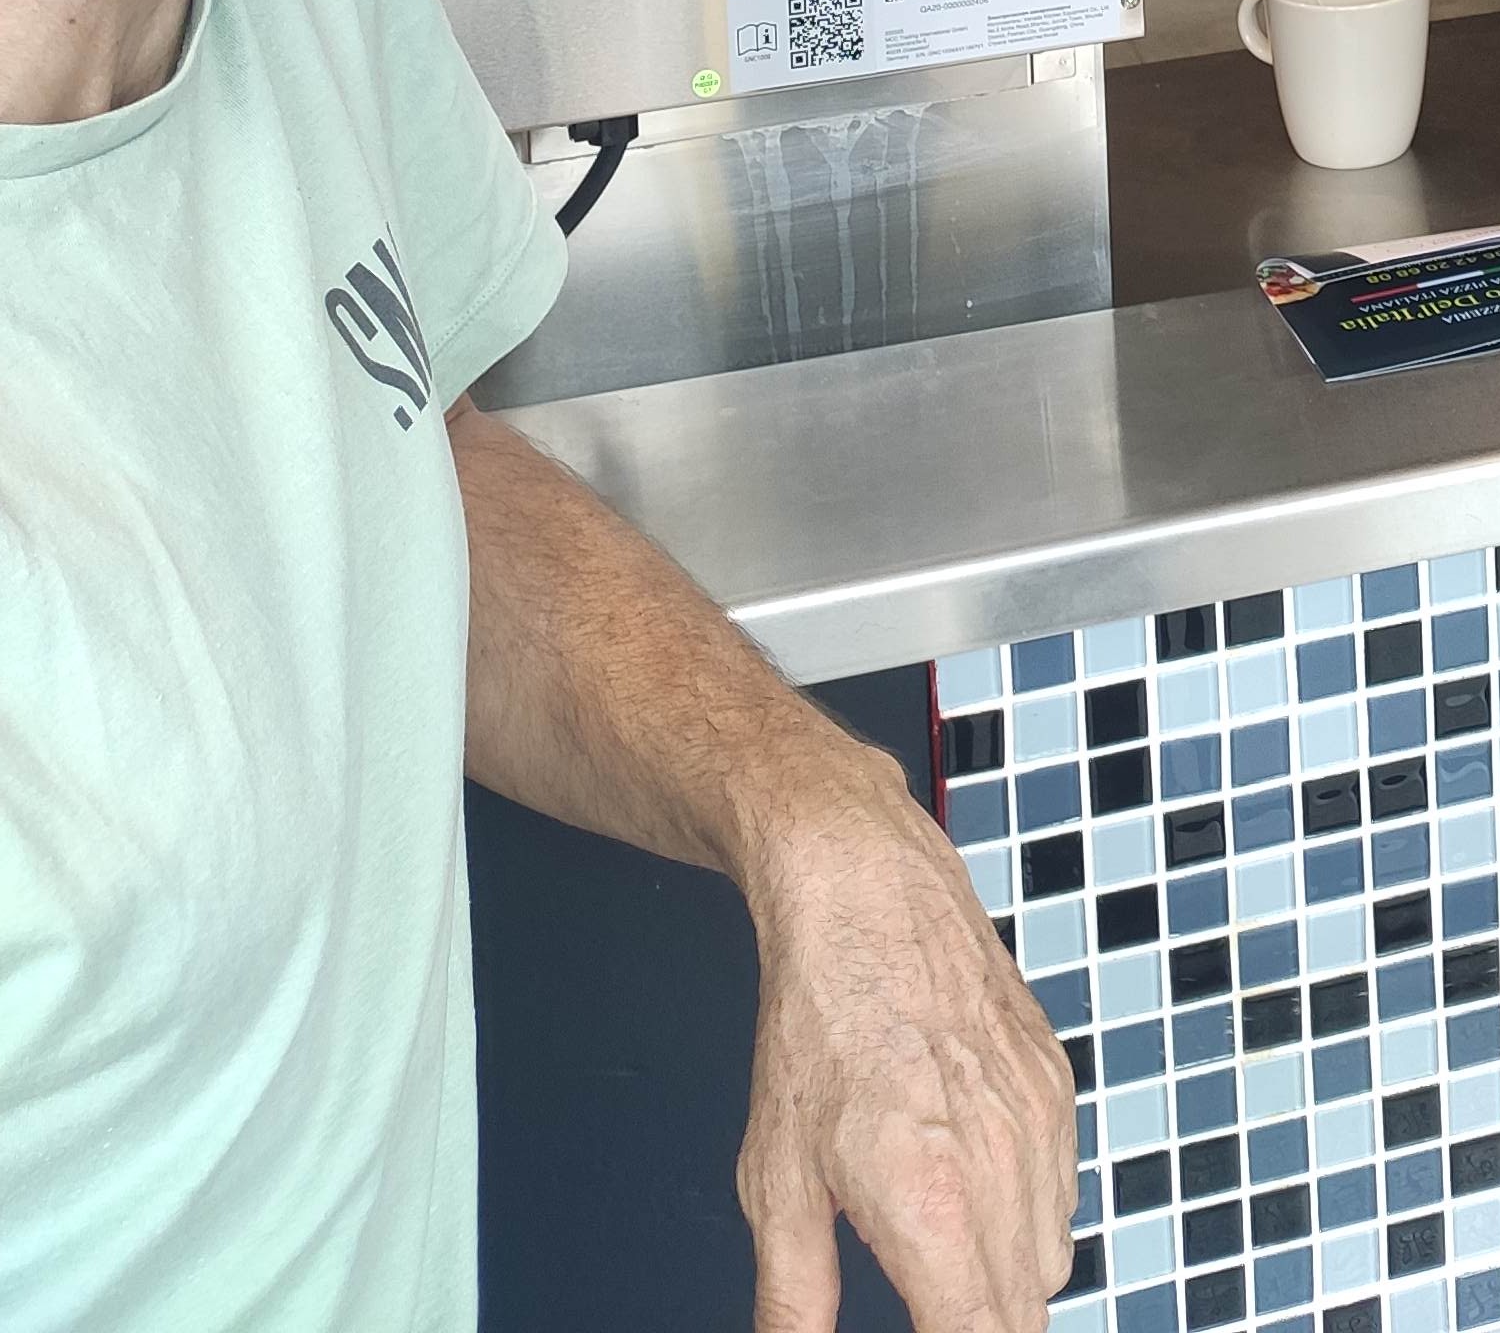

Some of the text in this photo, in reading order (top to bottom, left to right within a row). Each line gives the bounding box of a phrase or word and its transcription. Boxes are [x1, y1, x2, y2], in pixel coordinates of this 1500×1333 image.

[1426, 261, 1449, 273] 20
[1454, 256, 1477, 267] 42
[1438, 279, 1488, 297] PIZZA
[1358, 290, 1437, 313] ITALIANA
[1340, 294, 1480, 331] Dell'Italia
